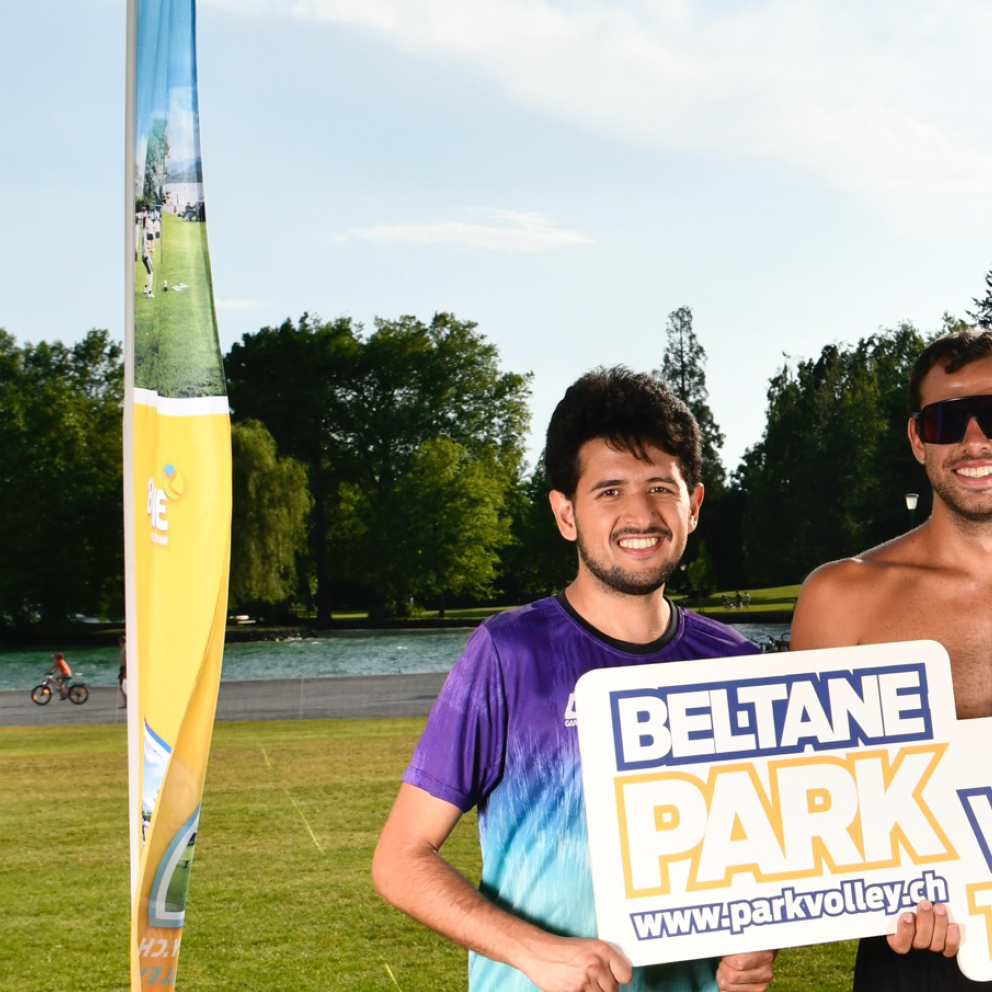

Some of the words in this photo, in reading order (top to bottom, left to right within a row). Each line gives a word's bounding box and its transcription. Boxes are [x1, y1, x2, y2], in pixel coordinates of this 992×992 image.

[611, 664, 933, 771] BELTANE
[614, 742, 960, 899] PARK
[630, 870, 950, 940] www.parkvolley.ch
